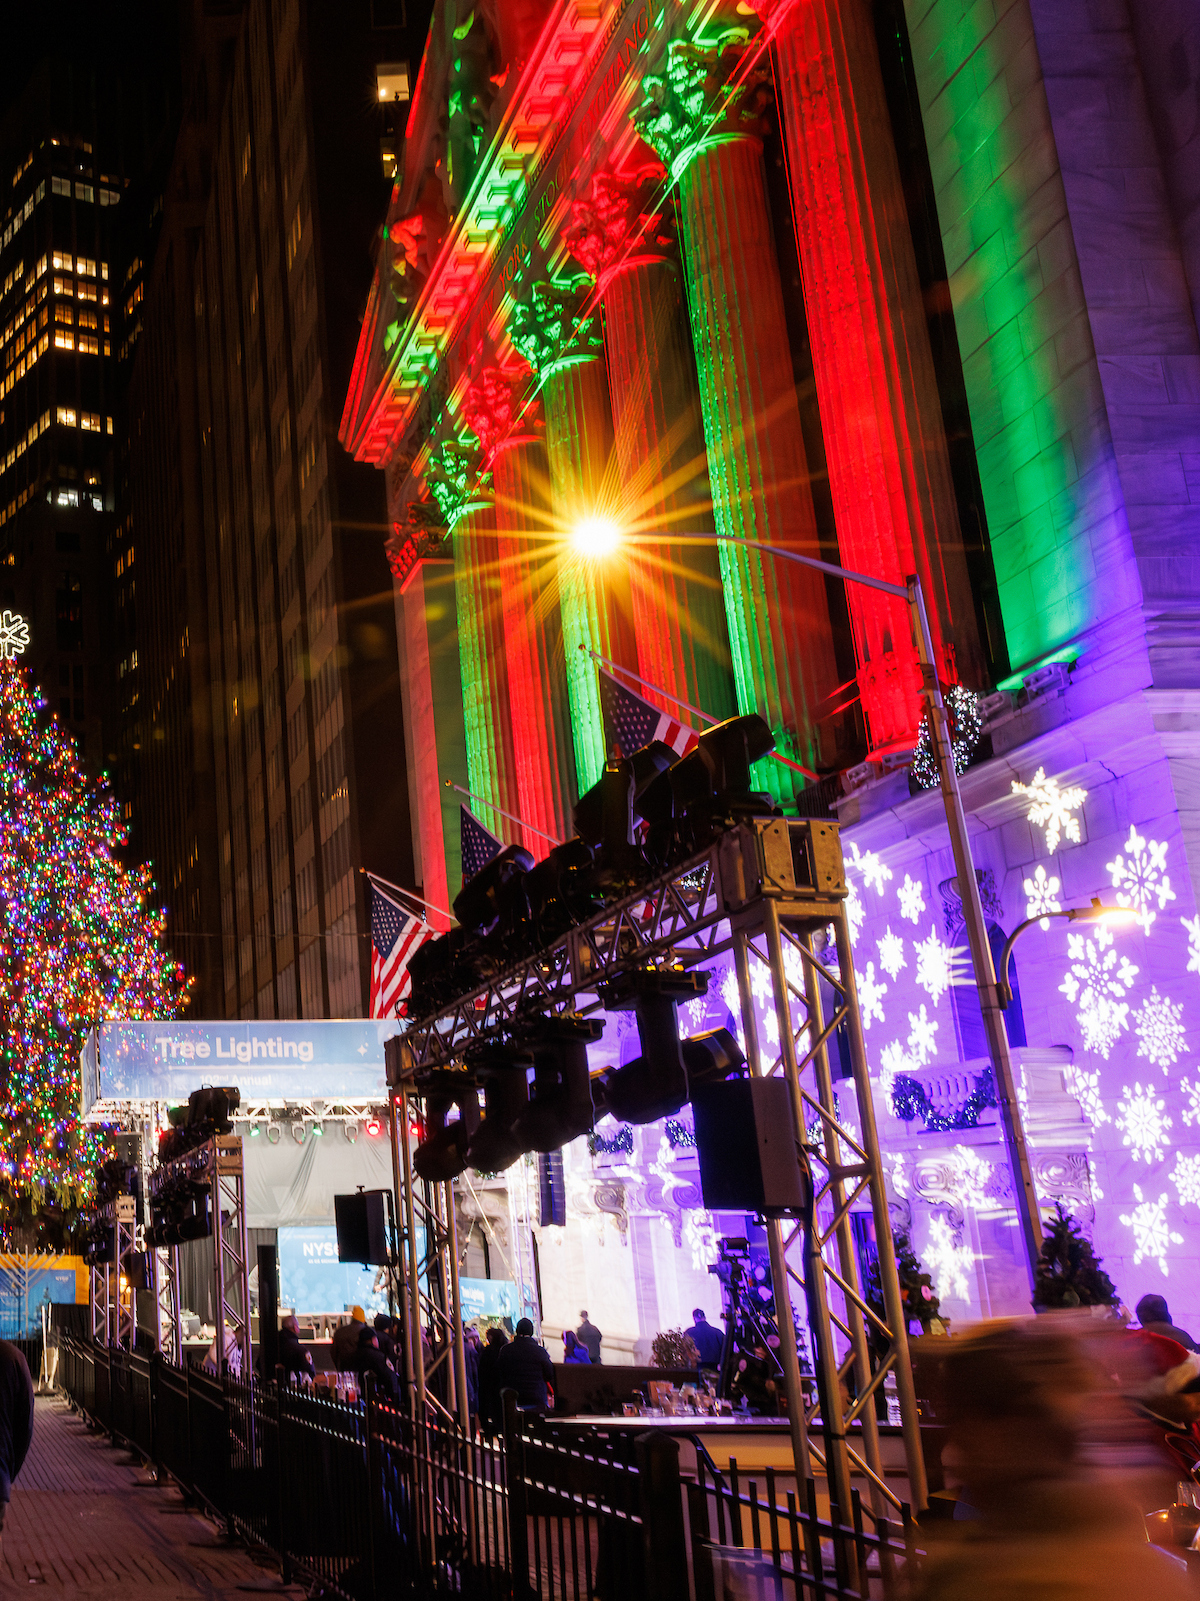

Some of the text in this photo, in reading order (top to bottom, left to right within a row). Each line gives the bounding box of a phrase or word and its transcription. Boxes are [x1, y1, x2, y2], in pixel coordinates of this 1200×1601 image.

[155, 1037, 314, 1063] Tree Lighting
[231, 1074, 272, 1086] Annual
